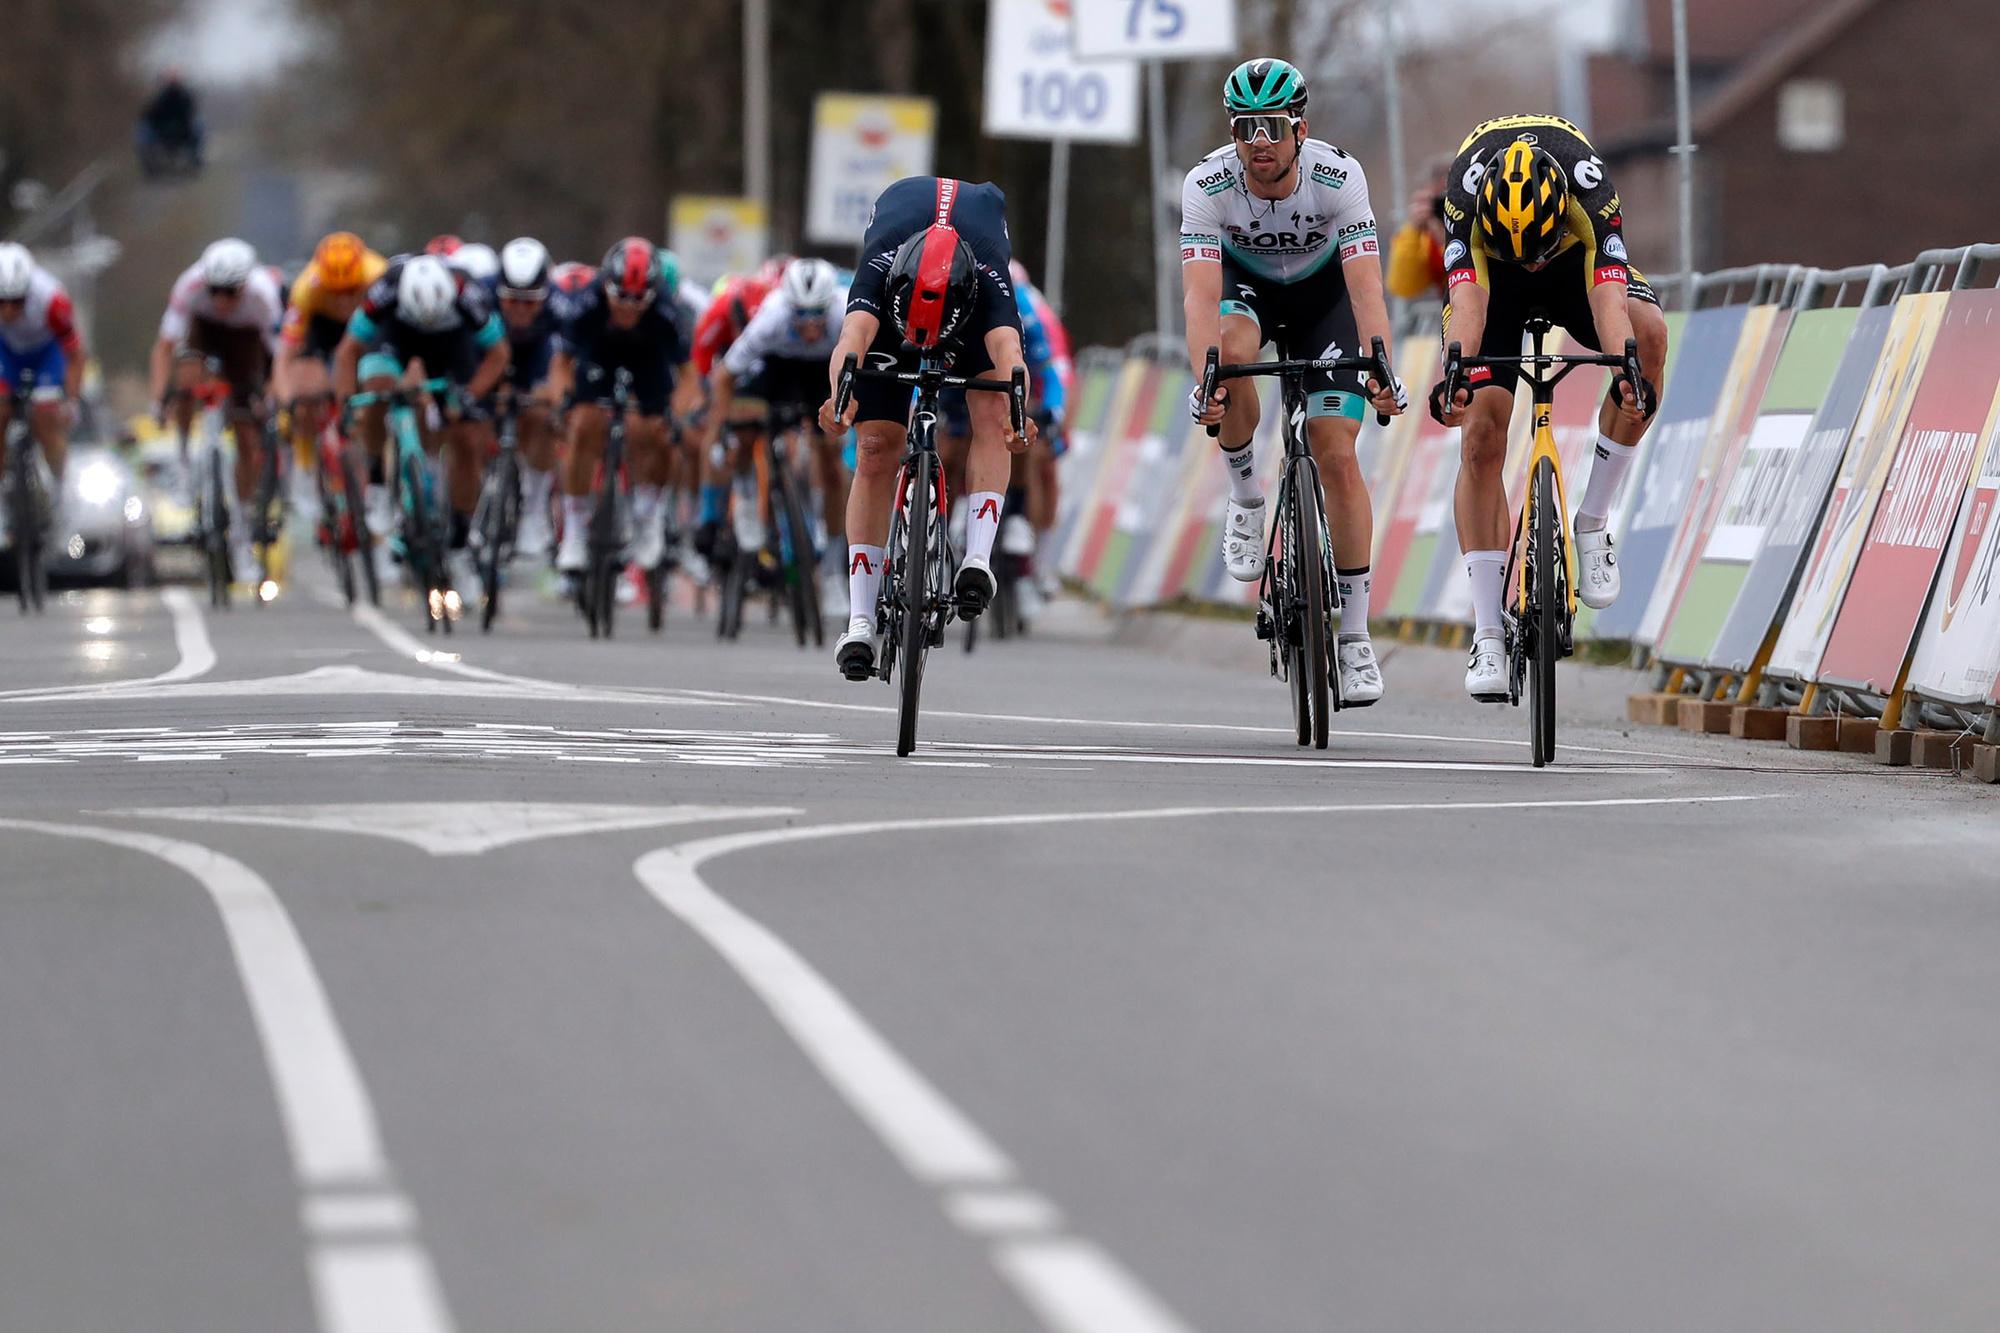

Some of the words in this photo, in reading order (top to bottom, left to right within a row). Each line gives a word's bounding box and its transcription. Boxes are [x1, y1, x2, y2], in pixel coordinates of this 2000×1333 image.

[1019, 71, 1109, 121] 100
[1196, 167, 1232, 189] BORA
[1312, 162, 1348, 181] BORA
[1338, 219, 1376, 238] BORA
[1231, 231, 1327, 248] BORA
[1312, 359, 1336, 369] PRO
